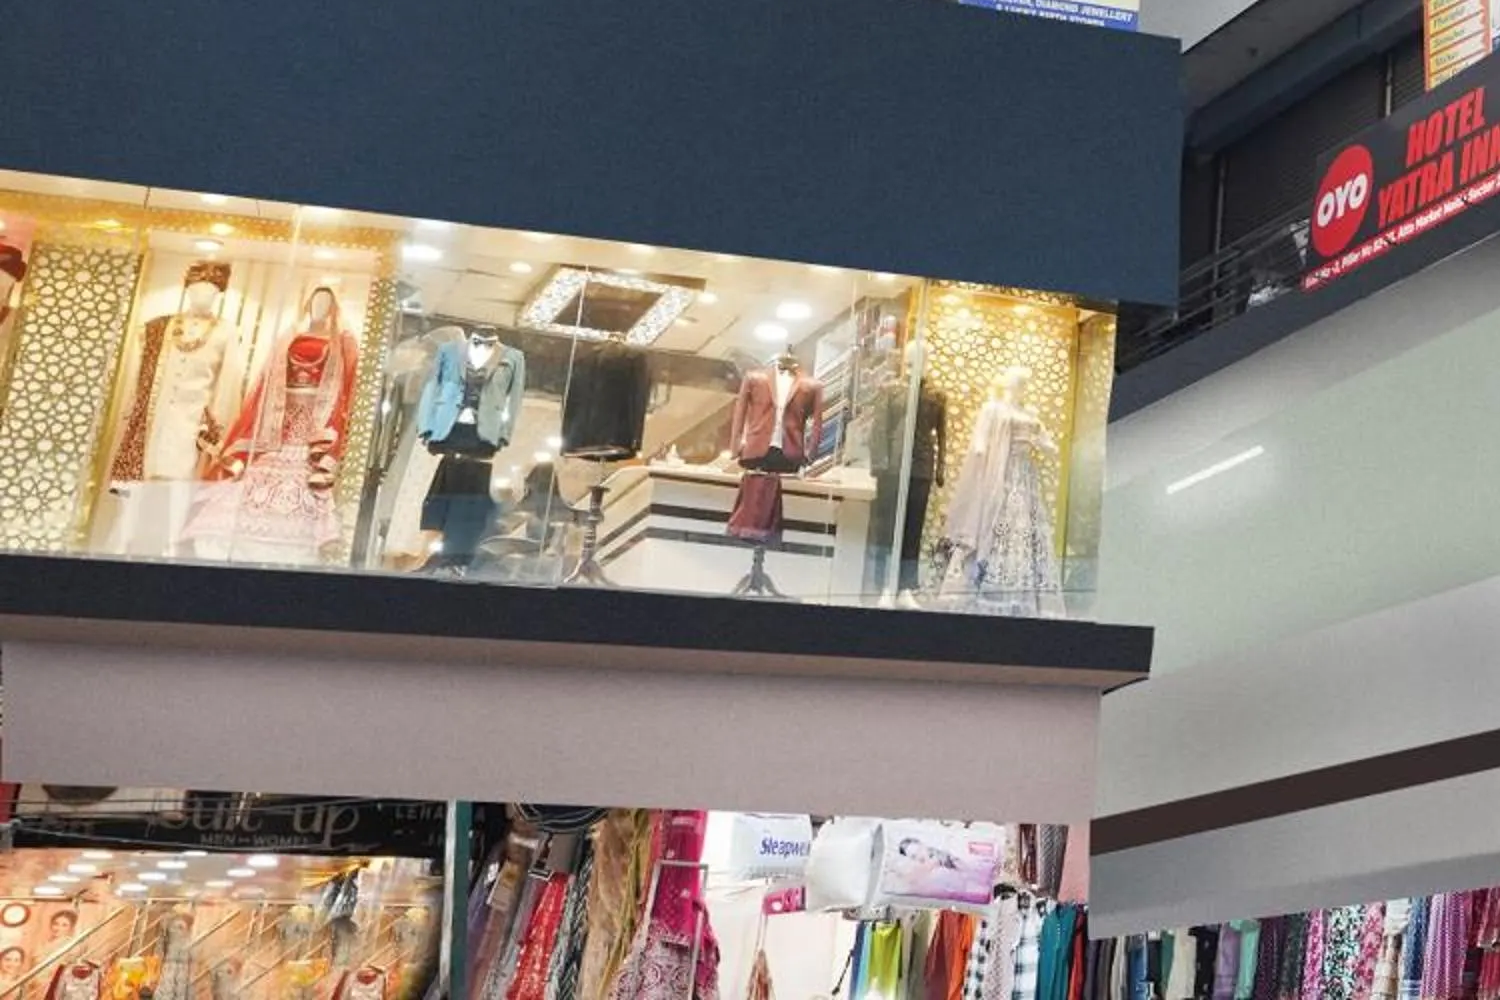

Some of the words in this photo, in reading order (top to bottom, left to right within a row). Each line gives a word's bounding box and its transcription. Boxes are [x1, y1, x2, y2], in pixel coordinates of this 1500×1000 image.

[1406, 87, 1485, 168] HOTEL
[1317, 173, 1367, 227] OYO
[1378, 151, 1454, 229] YATRA
